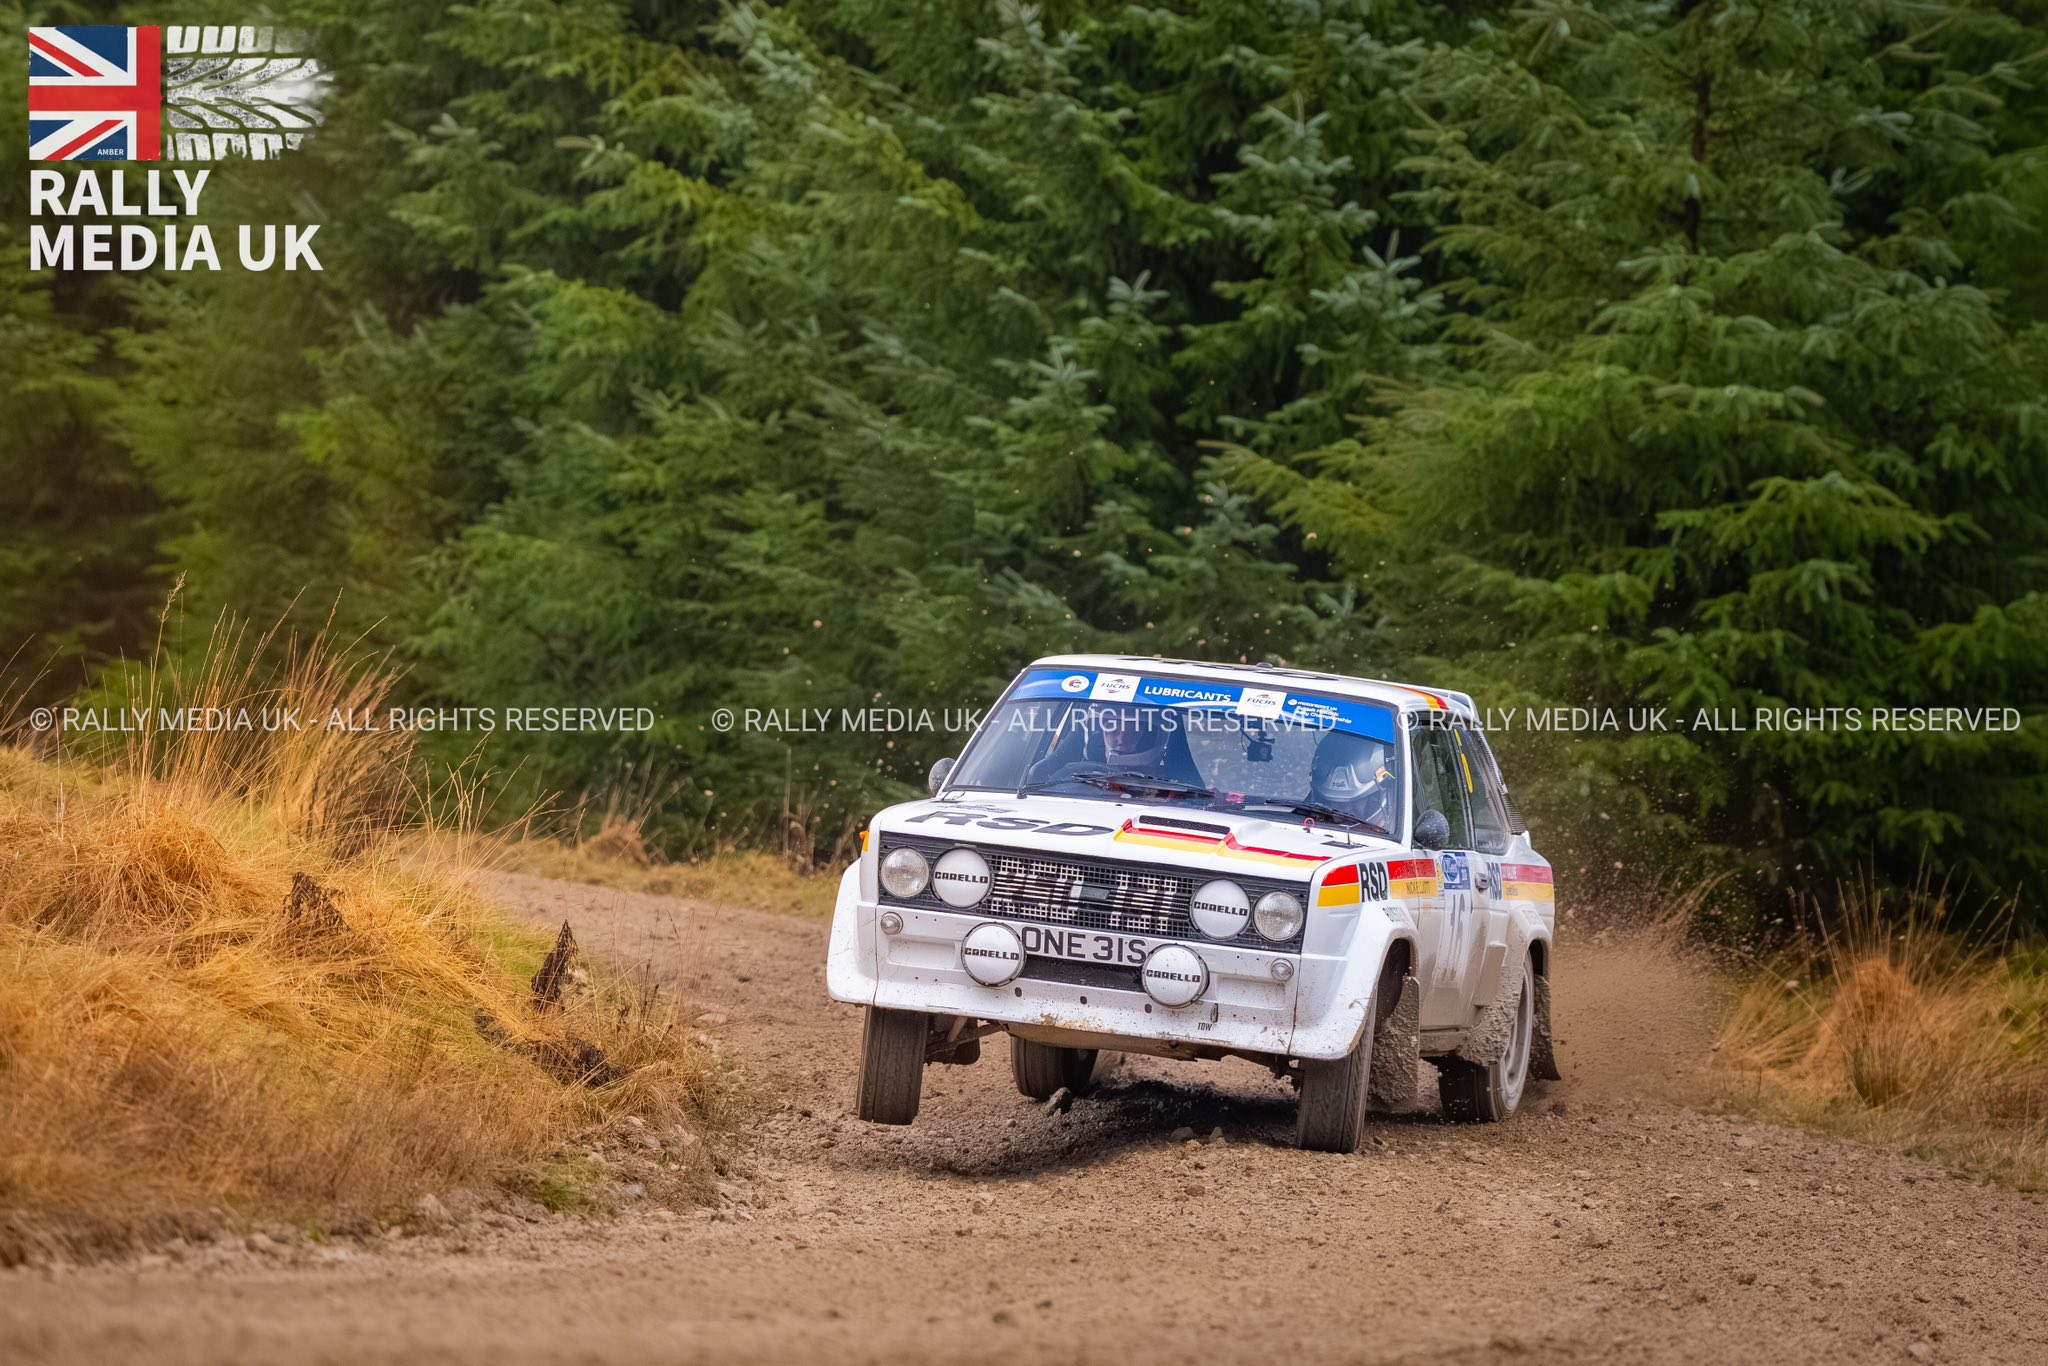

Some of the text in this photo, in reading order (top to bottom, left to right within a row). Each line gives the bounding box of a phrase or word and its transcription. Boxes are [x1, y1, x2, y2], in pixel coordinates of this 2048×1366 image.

[1144, 686, 1231, 703] LUBRICANTS
[1247, 697, 1277, 706] FUCHS
[904, 811, 1115, 836] RSD
[935, 871, 988, 883] CARELLO
[1359, 862, 1388, 903] RSD
[1194, 901, 1248, 916] CARELLO
[1022, 926, 1147, 964] ONE 31S
[964, 947, 1020, 960] CARELLO
[1146, 969, 1201, 982] CARELLO
[1197, 1022, 1212, 1031] TOW
